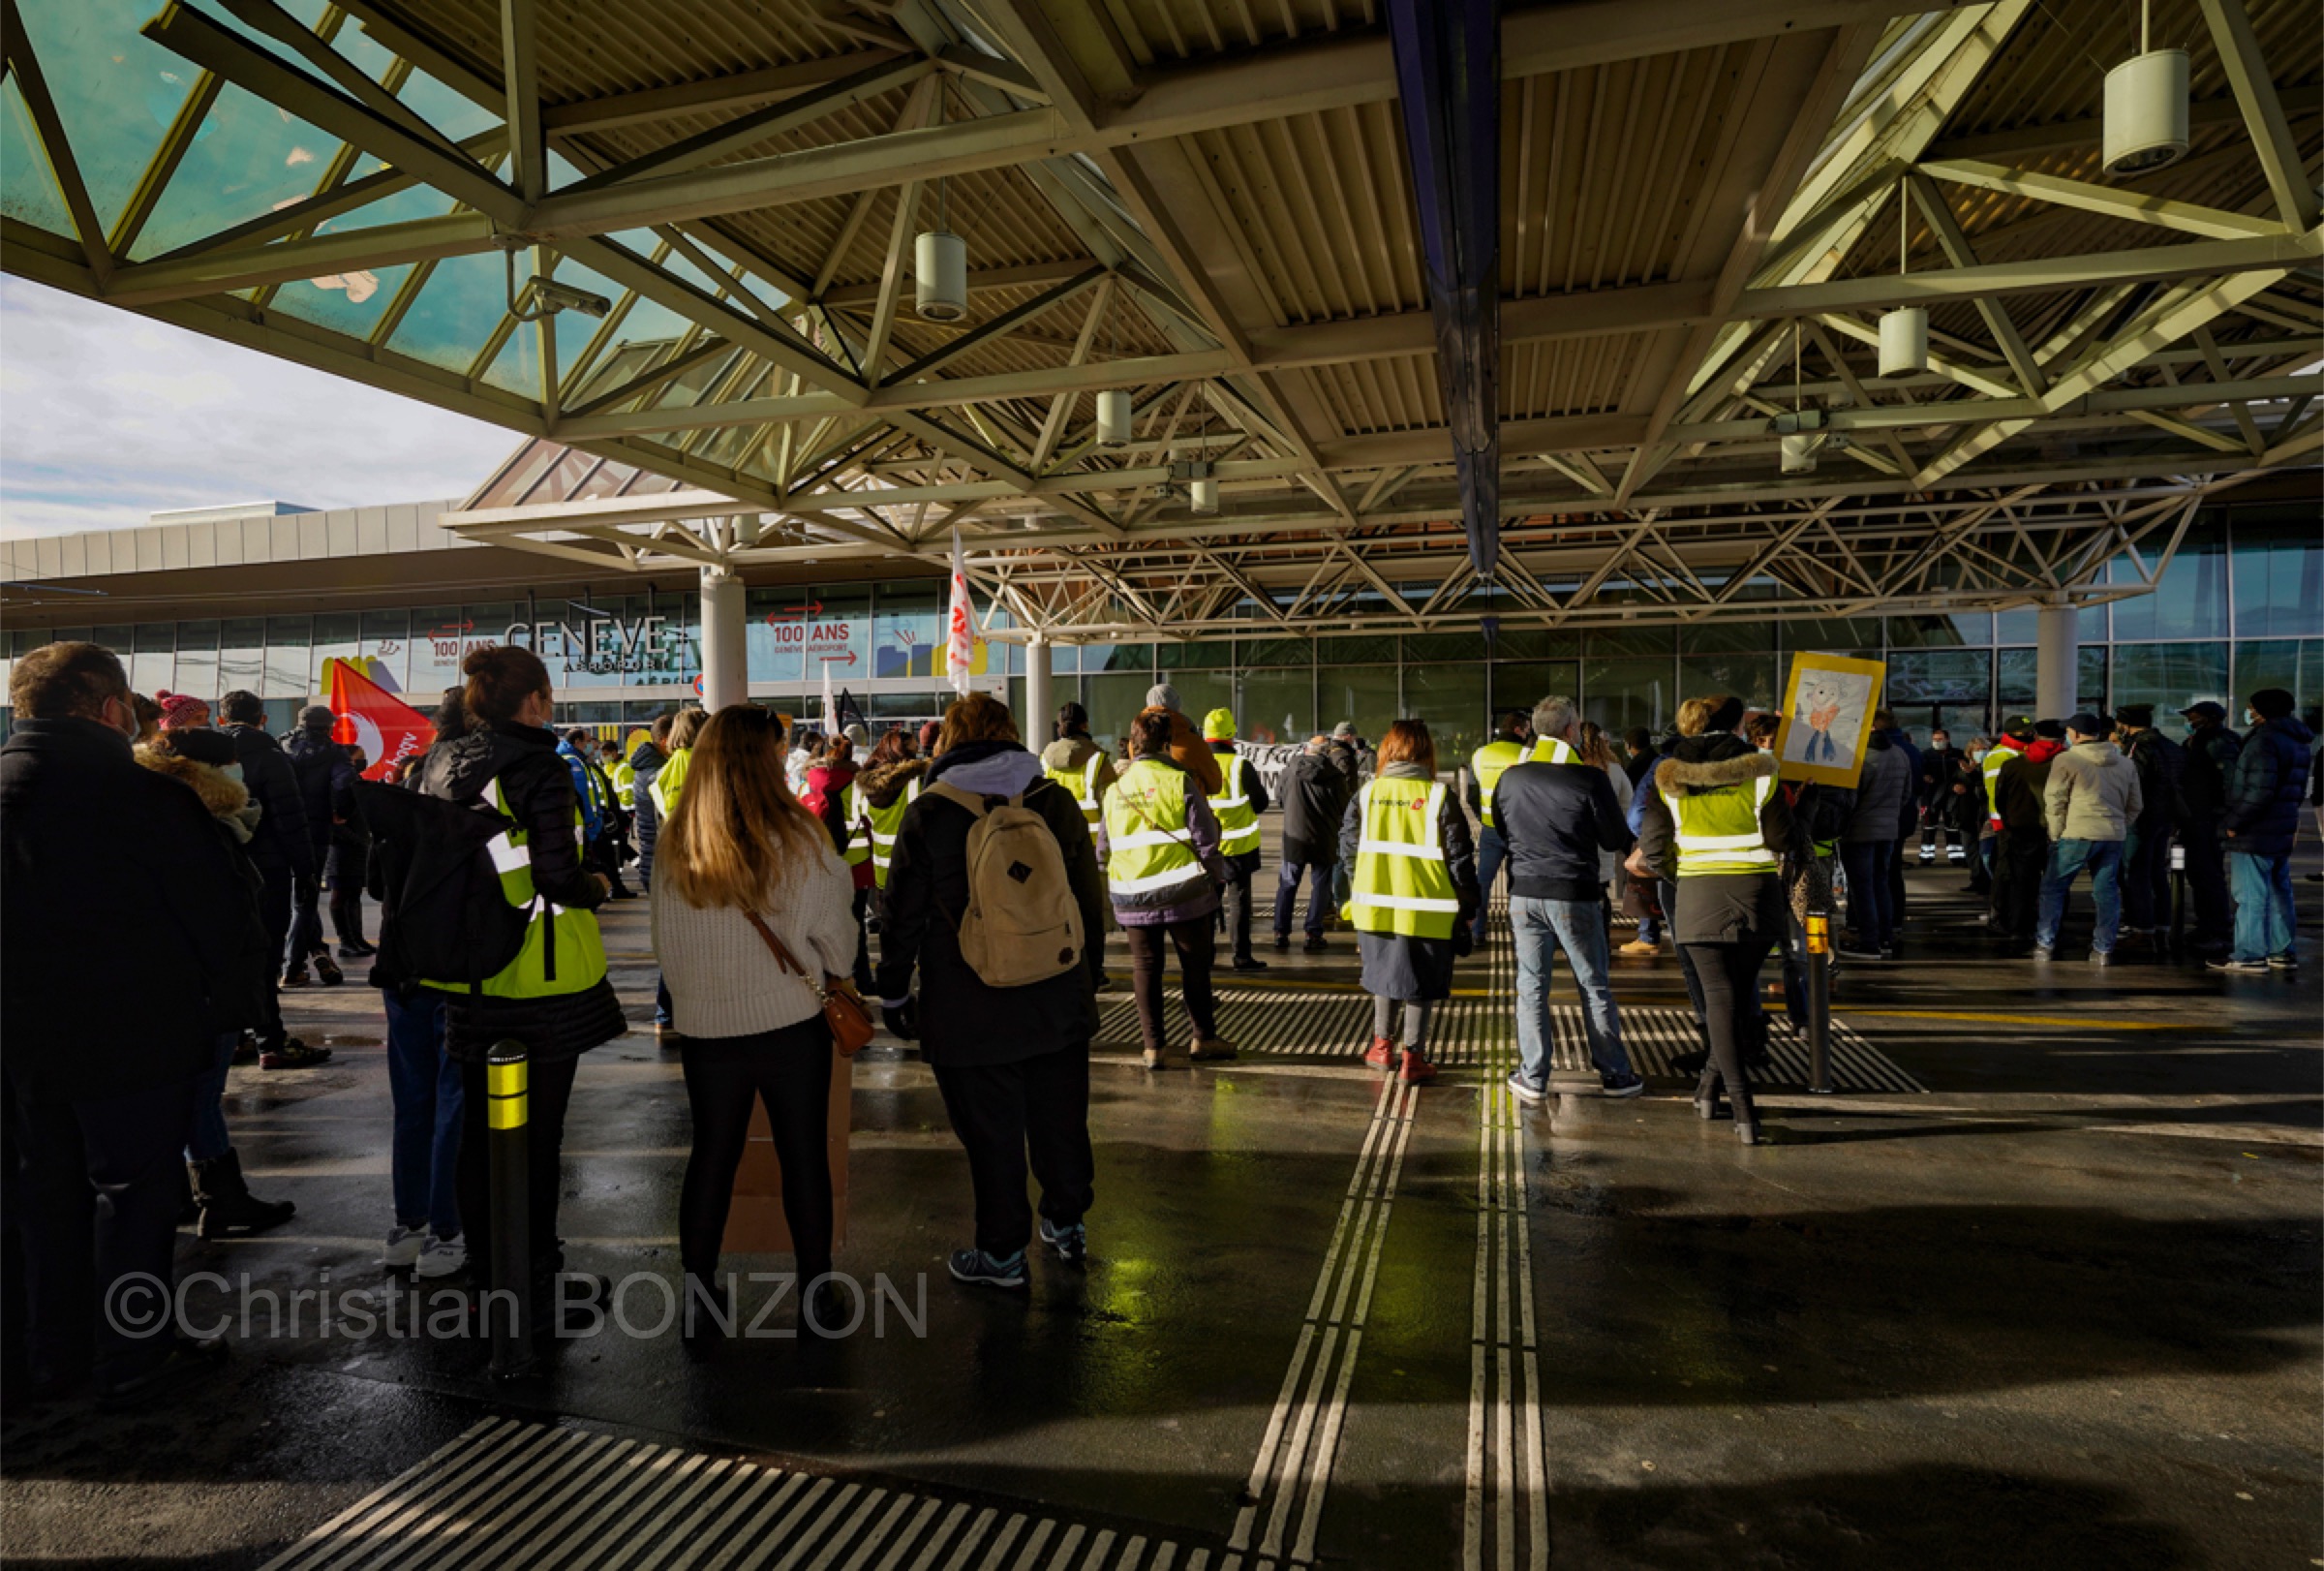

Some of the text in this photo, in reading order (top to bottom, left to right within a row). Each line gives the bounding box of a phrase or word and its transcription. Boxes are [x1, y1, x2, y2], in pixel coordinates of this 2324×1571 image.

[774, 623, 849, 643] 100 ANS
[434, 640, 458, 657] 100
